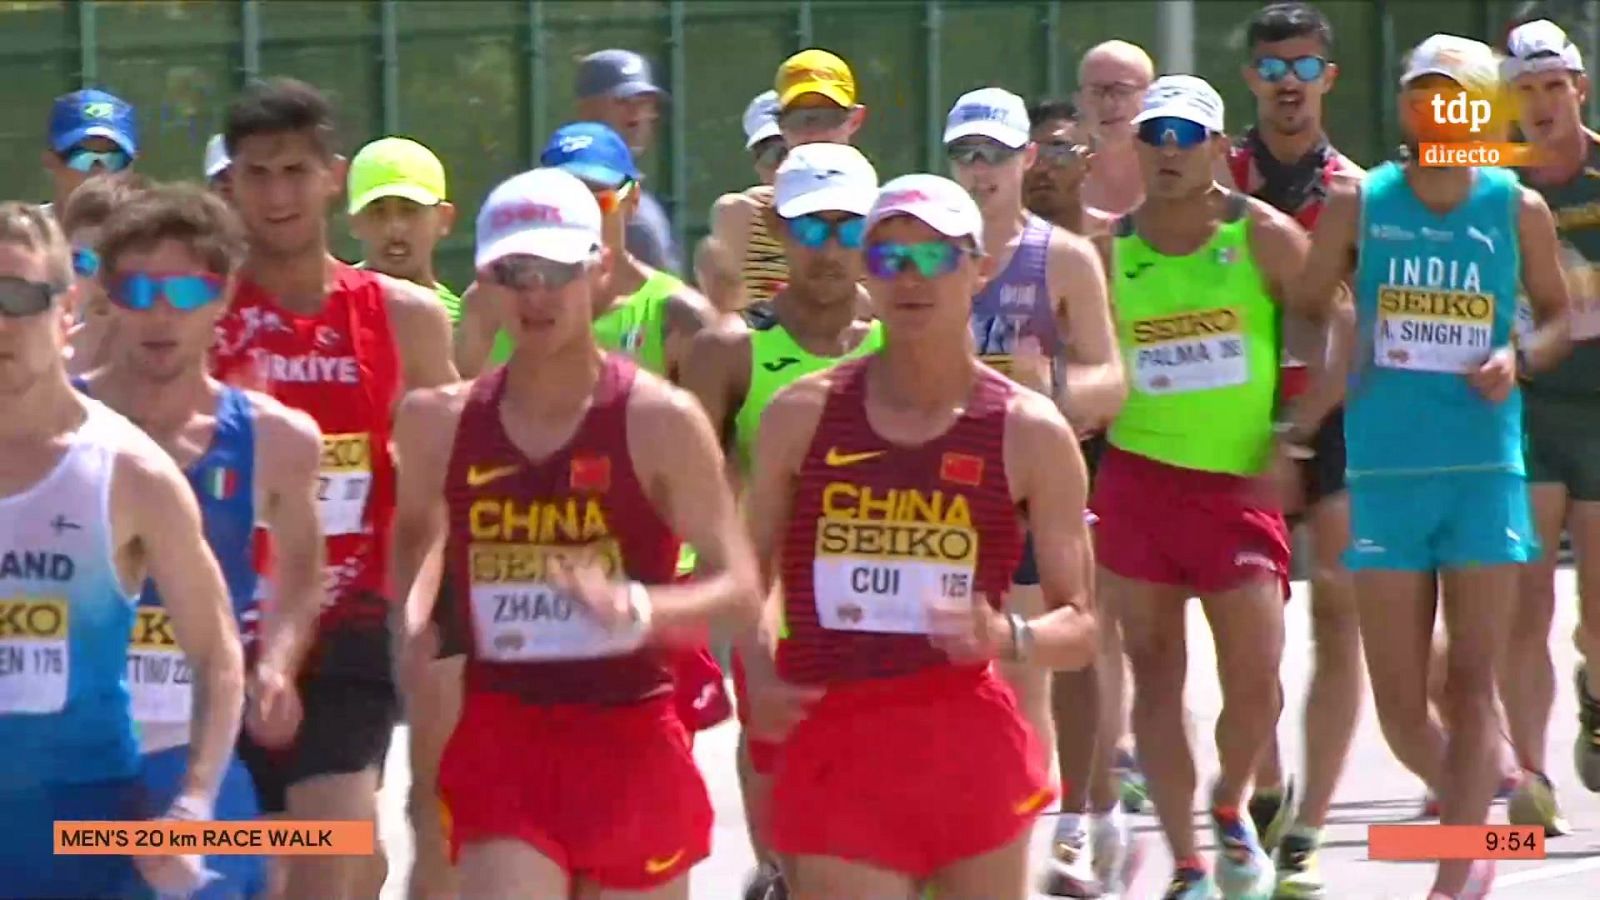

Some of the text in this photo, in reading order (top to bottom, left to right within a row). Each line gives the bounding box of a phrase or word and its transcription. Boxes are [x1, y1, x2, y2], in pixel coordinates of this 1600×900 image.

[1389, 256, 1481, 293] INDIA
[1381, 289, 1490, 319] SEIKO
[1401, 321, 1462, 346] SINGH
[469, 498, 608, 542] CHINA
[823, 482, 972, 528] CHINA
[822, 523, 971, 560] SEIKO
[852, 567, 900, 595] CUI
[493, 594, 572, 623] ZHAO
